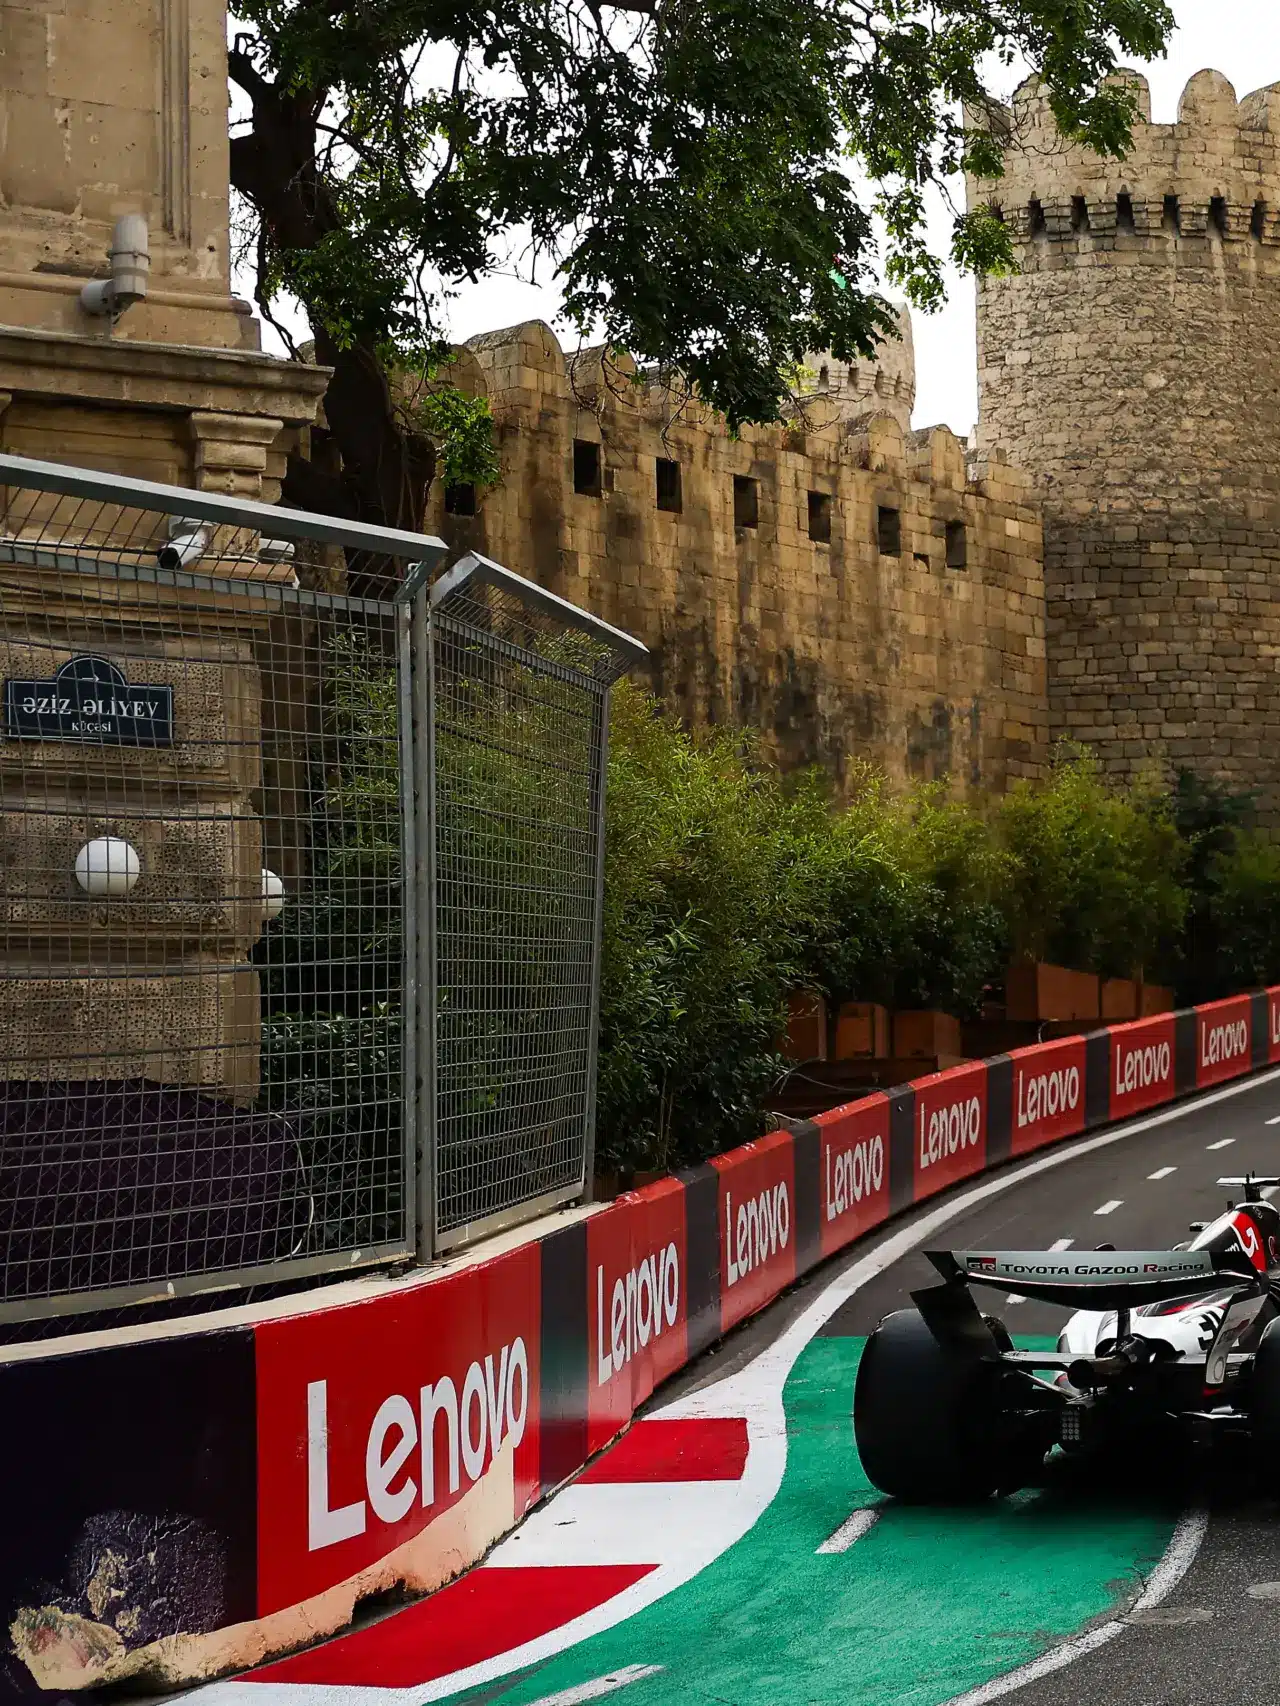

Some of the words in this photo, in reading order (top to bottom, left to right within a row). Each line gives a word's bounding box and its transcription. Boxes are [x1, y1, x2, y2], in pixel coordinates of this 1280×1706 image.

[22, 693, 72, 715] ƏZİZ
[83, 696, 159, 717] ƏLİYEV
[1116, 1041, 1170, 1095] Lenovo
[1201, 1019, 1248, 1067] Lenovo
[1017, 1066, 1079, 1128] Lenovo
[920, 1096, 980, 1169] Lenovo
[826, 1134, 884, 1222] Lenovo
[726, 1181, 790, 1287] Lenovo
[1001, 1263, 1070, 1275] TOYOTA
[1074, 1264, 1139, 1275] GAZOO
[1143, 1263, 1205, 1274] Racing
[597, 1242, 679, 1388] Lenovo
[307, 1335, 530, 1552] Lenovo
